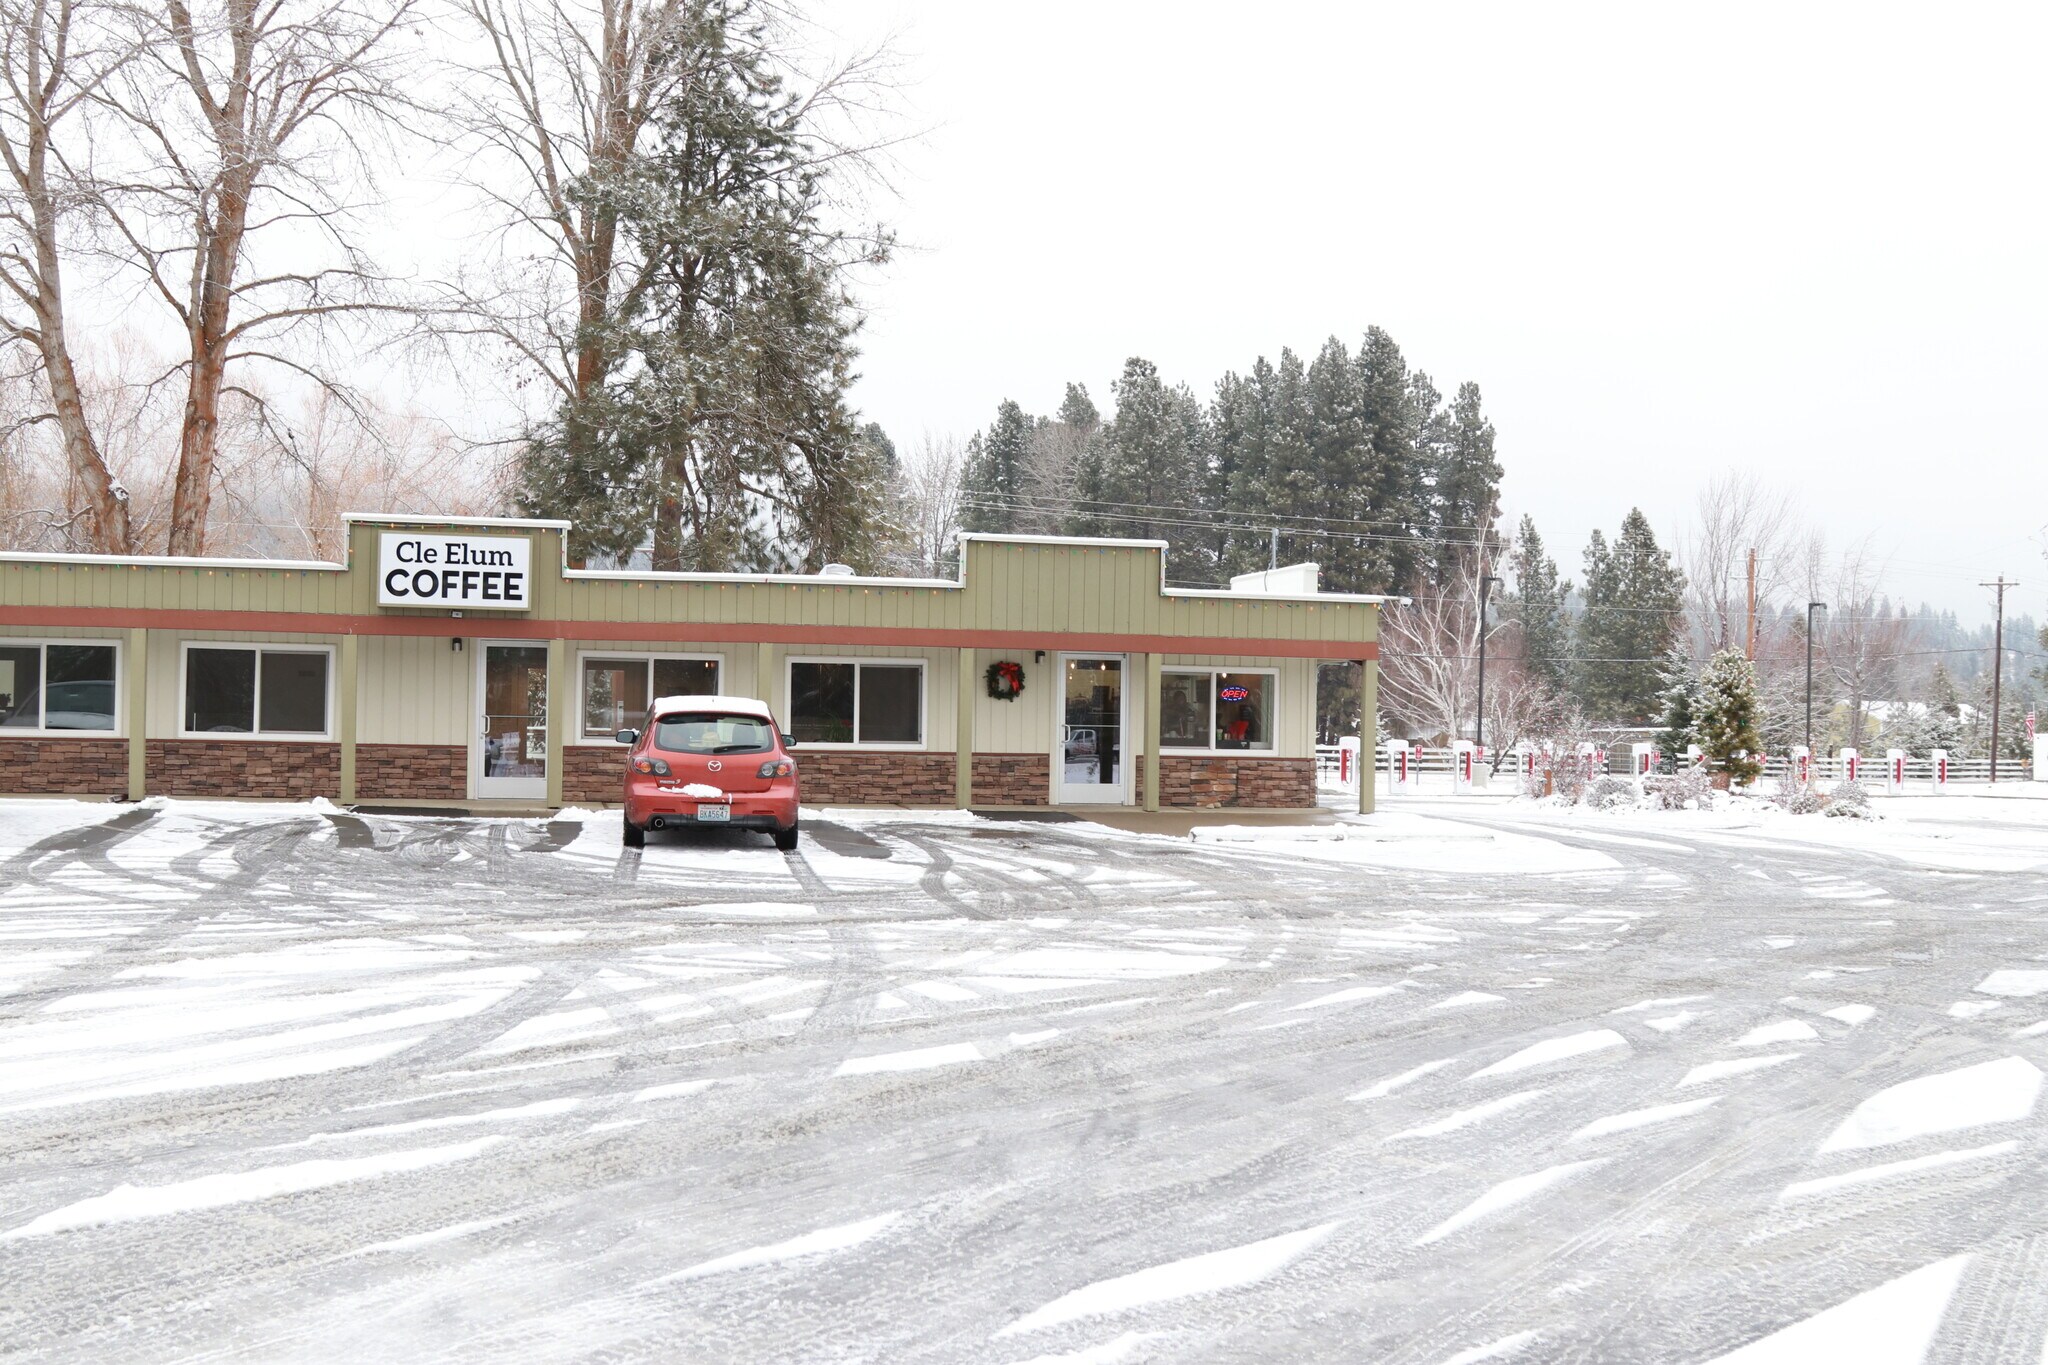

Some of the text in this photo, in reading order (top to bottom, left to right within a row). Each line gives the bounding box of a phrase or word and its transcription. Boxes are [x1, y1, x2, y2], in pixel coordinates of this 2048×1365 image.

[396, 541, 513, 566] Cle Elum
[385, 568, 523, 600] COFFEE
[1221, 690, 1248, 698] OPEN
[699, 810, 728, 819] BKA5647
